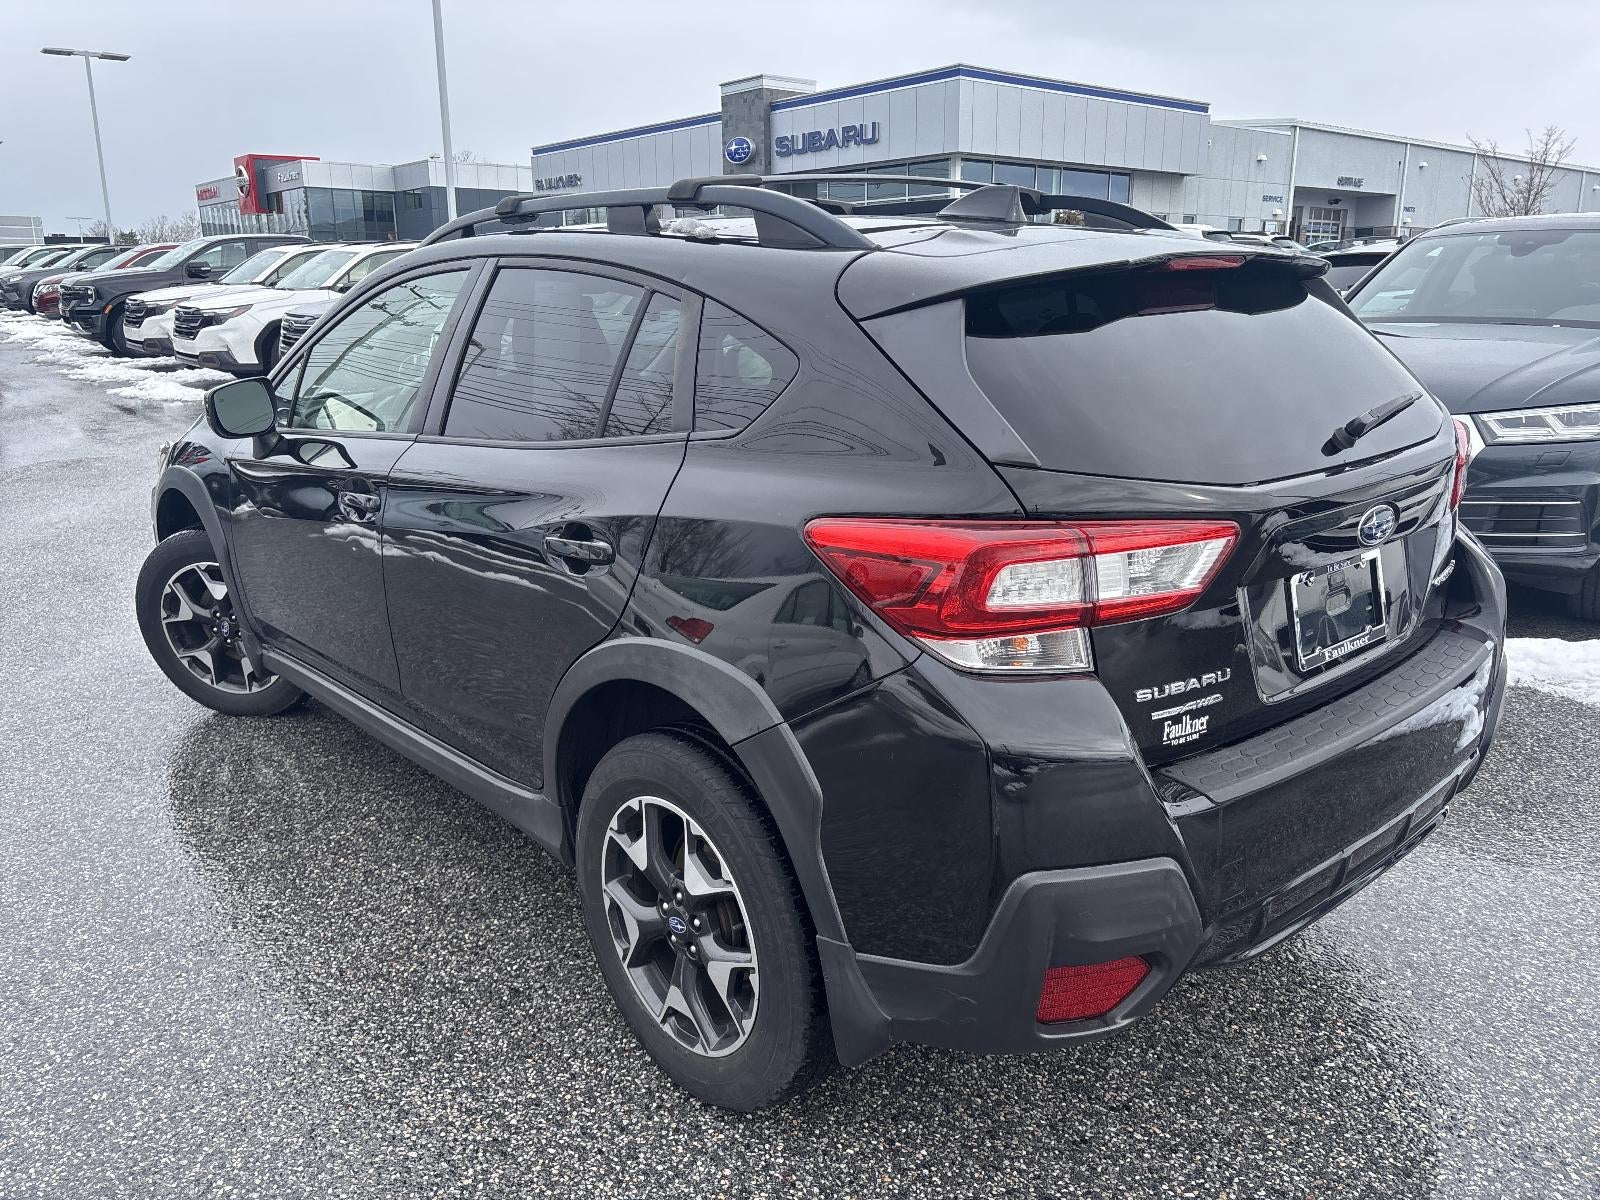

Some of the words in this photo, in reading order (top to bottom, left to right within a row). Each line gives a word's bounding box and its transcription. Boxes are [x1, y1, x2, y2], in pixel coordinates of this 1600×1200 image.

[775, 121, 880, 158] SUBARU
[1262, 194, 1284, 204] SERVICE
[1324, 635, 1370, 661] Faulkner
[1135, 667, 1231, 703] SUBARU
[1162, 714, 1209, 741] Faulkner
[1186, 733, 1200, 742] SURE
